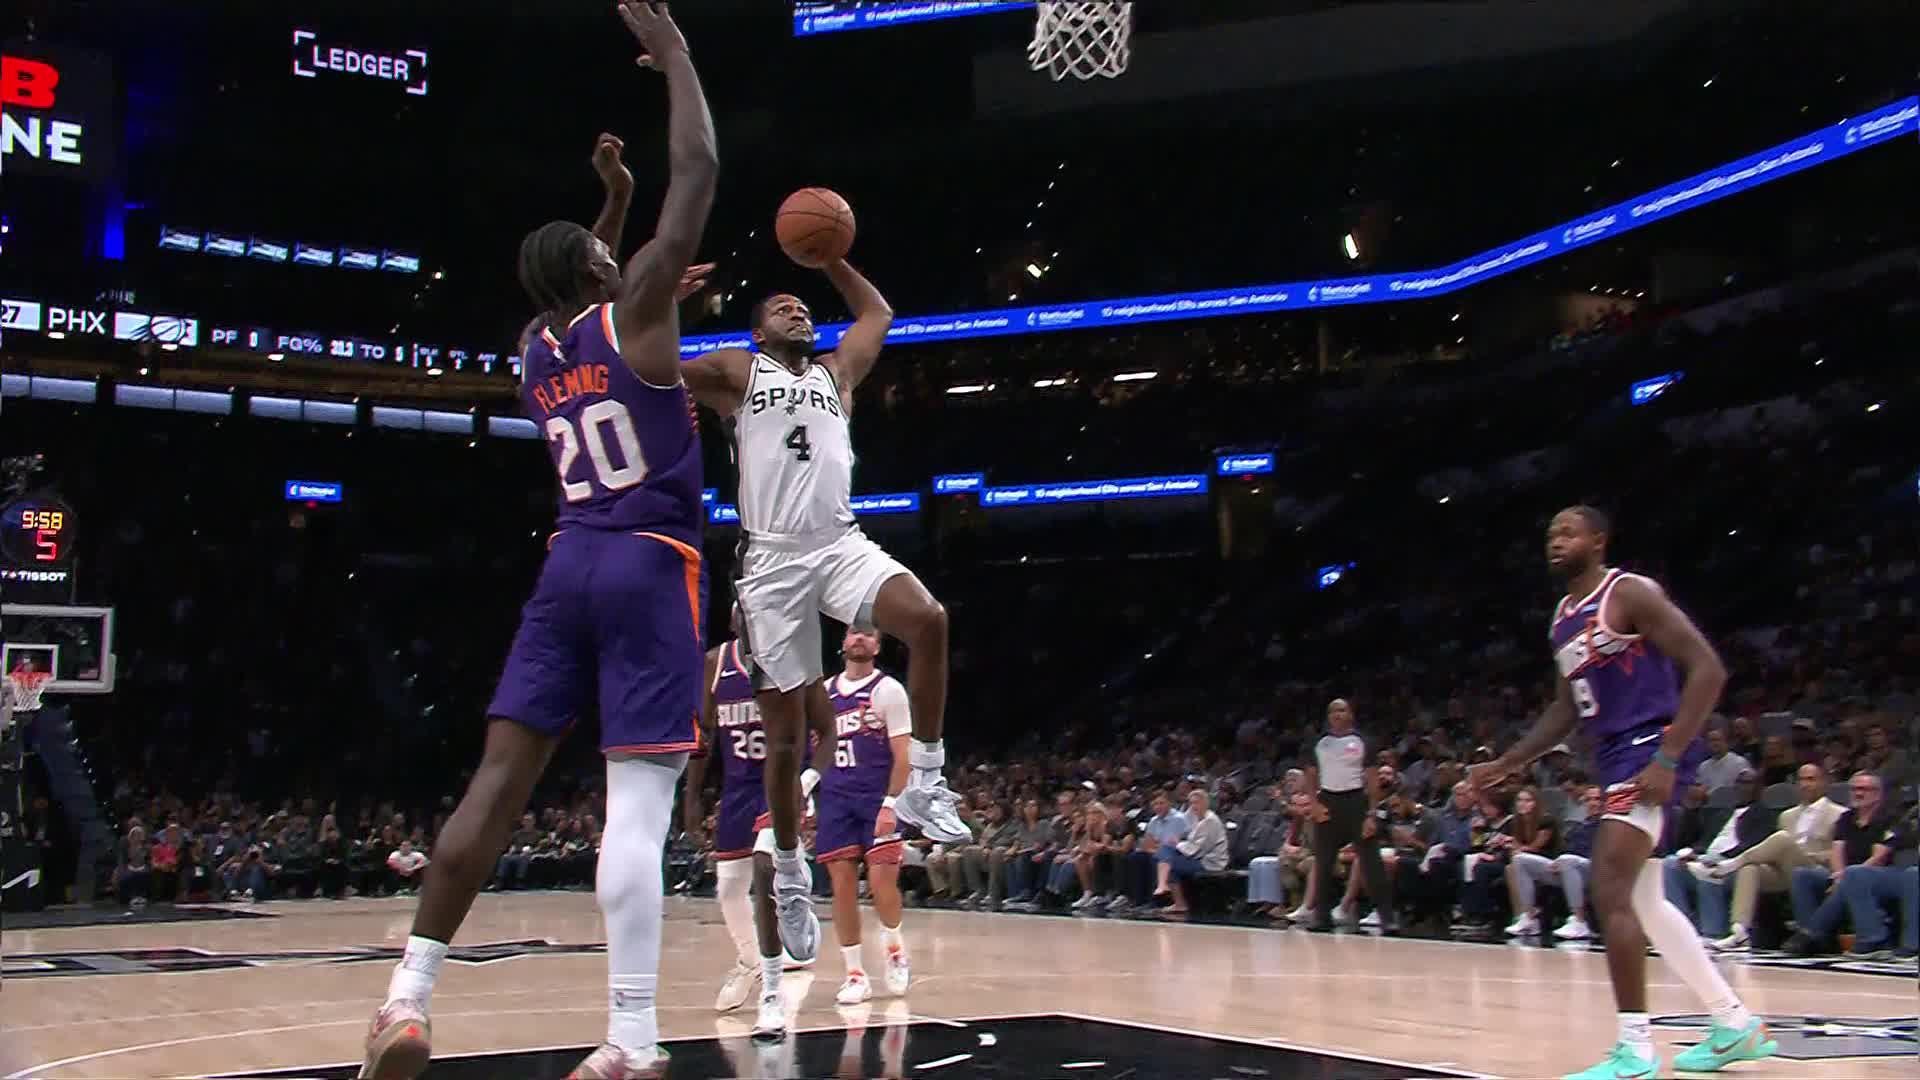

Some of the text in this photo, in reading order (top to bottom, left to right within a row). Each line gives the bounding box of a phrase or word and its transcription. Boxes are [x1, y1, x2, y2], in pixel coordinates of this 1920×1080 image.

[313, 44, 409, 81] LEDGER
[48, 307, 107, 335] PHX
[211, 329, 239, 345] PF
[359, 344, 386, 360] TO
[751, 386, 840, 418] SPURS
[544, 398, 650, 504] 20
[786, 425, 812, 461] 4
[22, 511, 63, 530] 9:58
[36, 530, 57, 560] 5
[18, 570, 67, 581] TISSOT
[730, 730, 768, 760] 26
